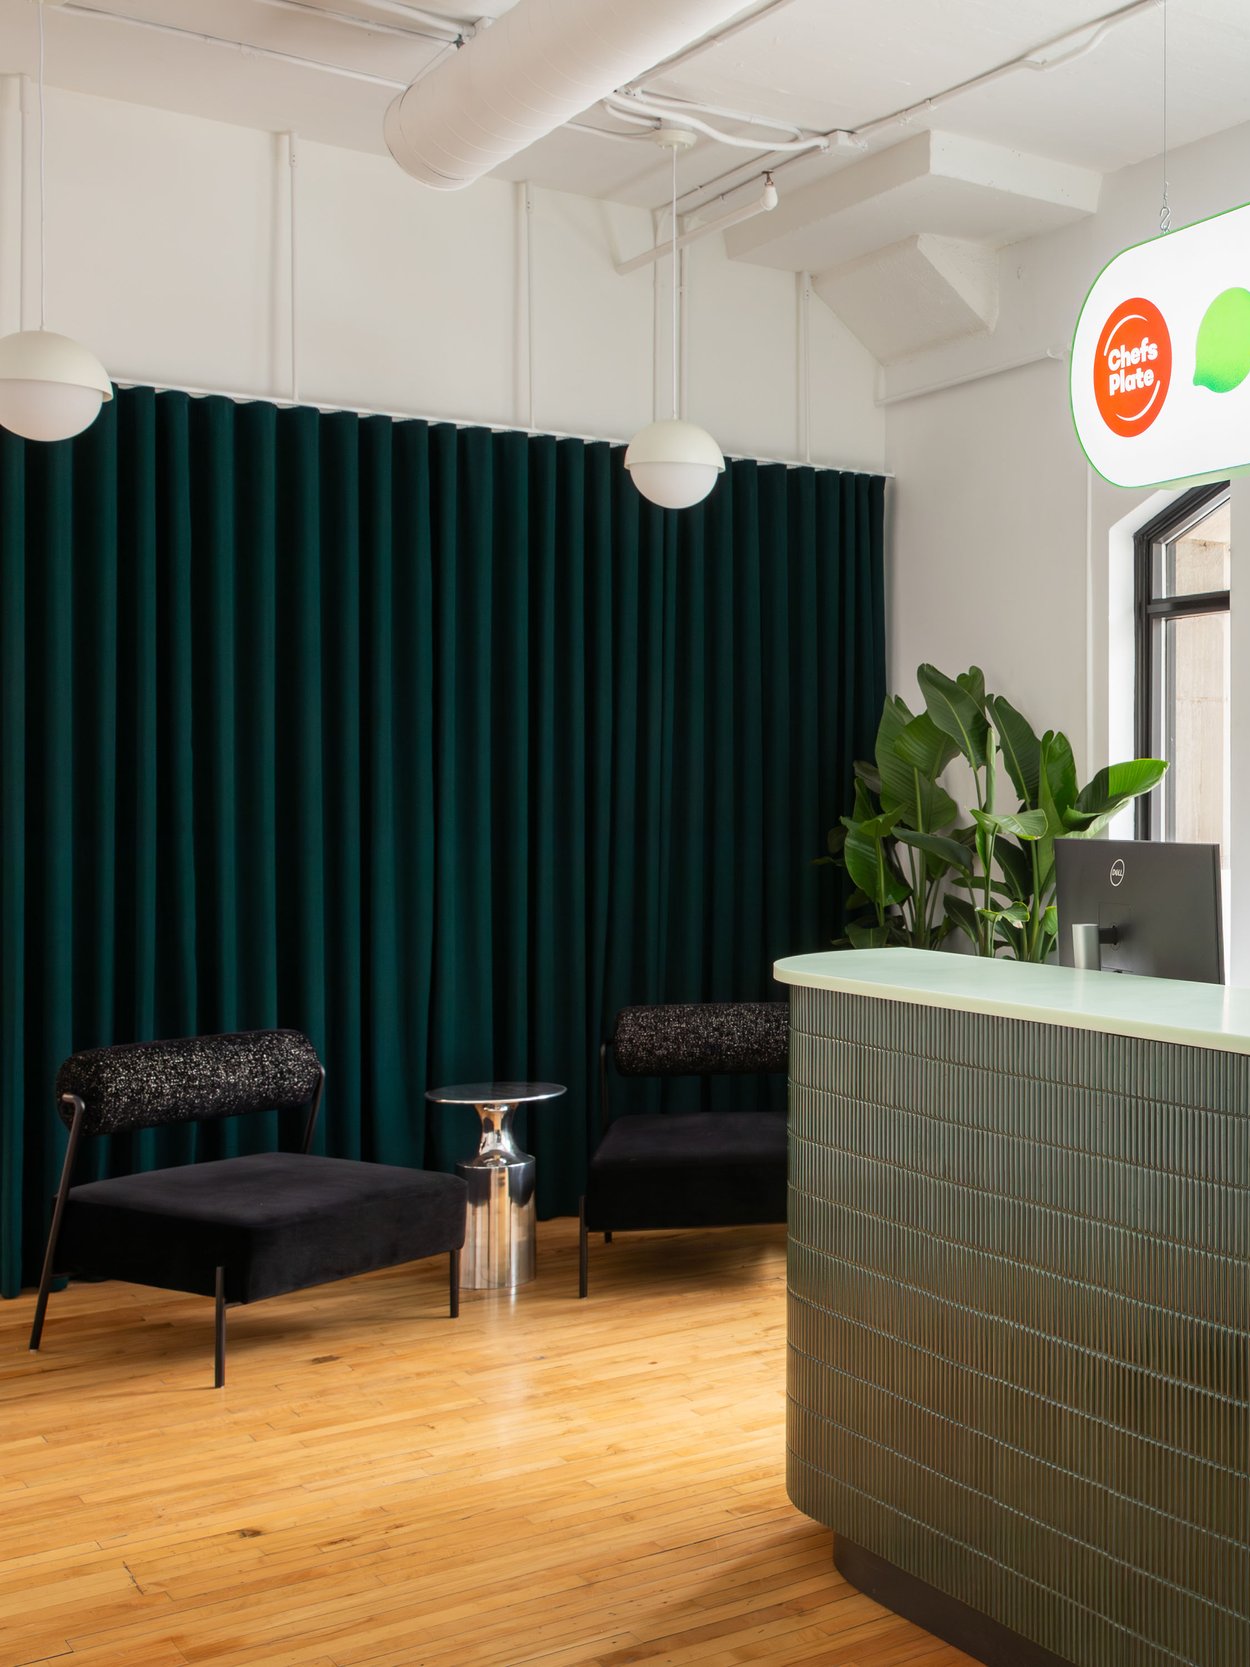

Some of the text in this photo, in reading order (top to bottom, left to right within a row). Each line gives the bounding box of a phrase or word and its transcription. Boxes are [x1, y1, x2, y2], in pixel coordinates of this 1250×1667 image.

[1107, 337, 1159, 371] Chefs
[1108, 368, 1155, 397] Plate
[1111, 868, 1123, 877] DELL
